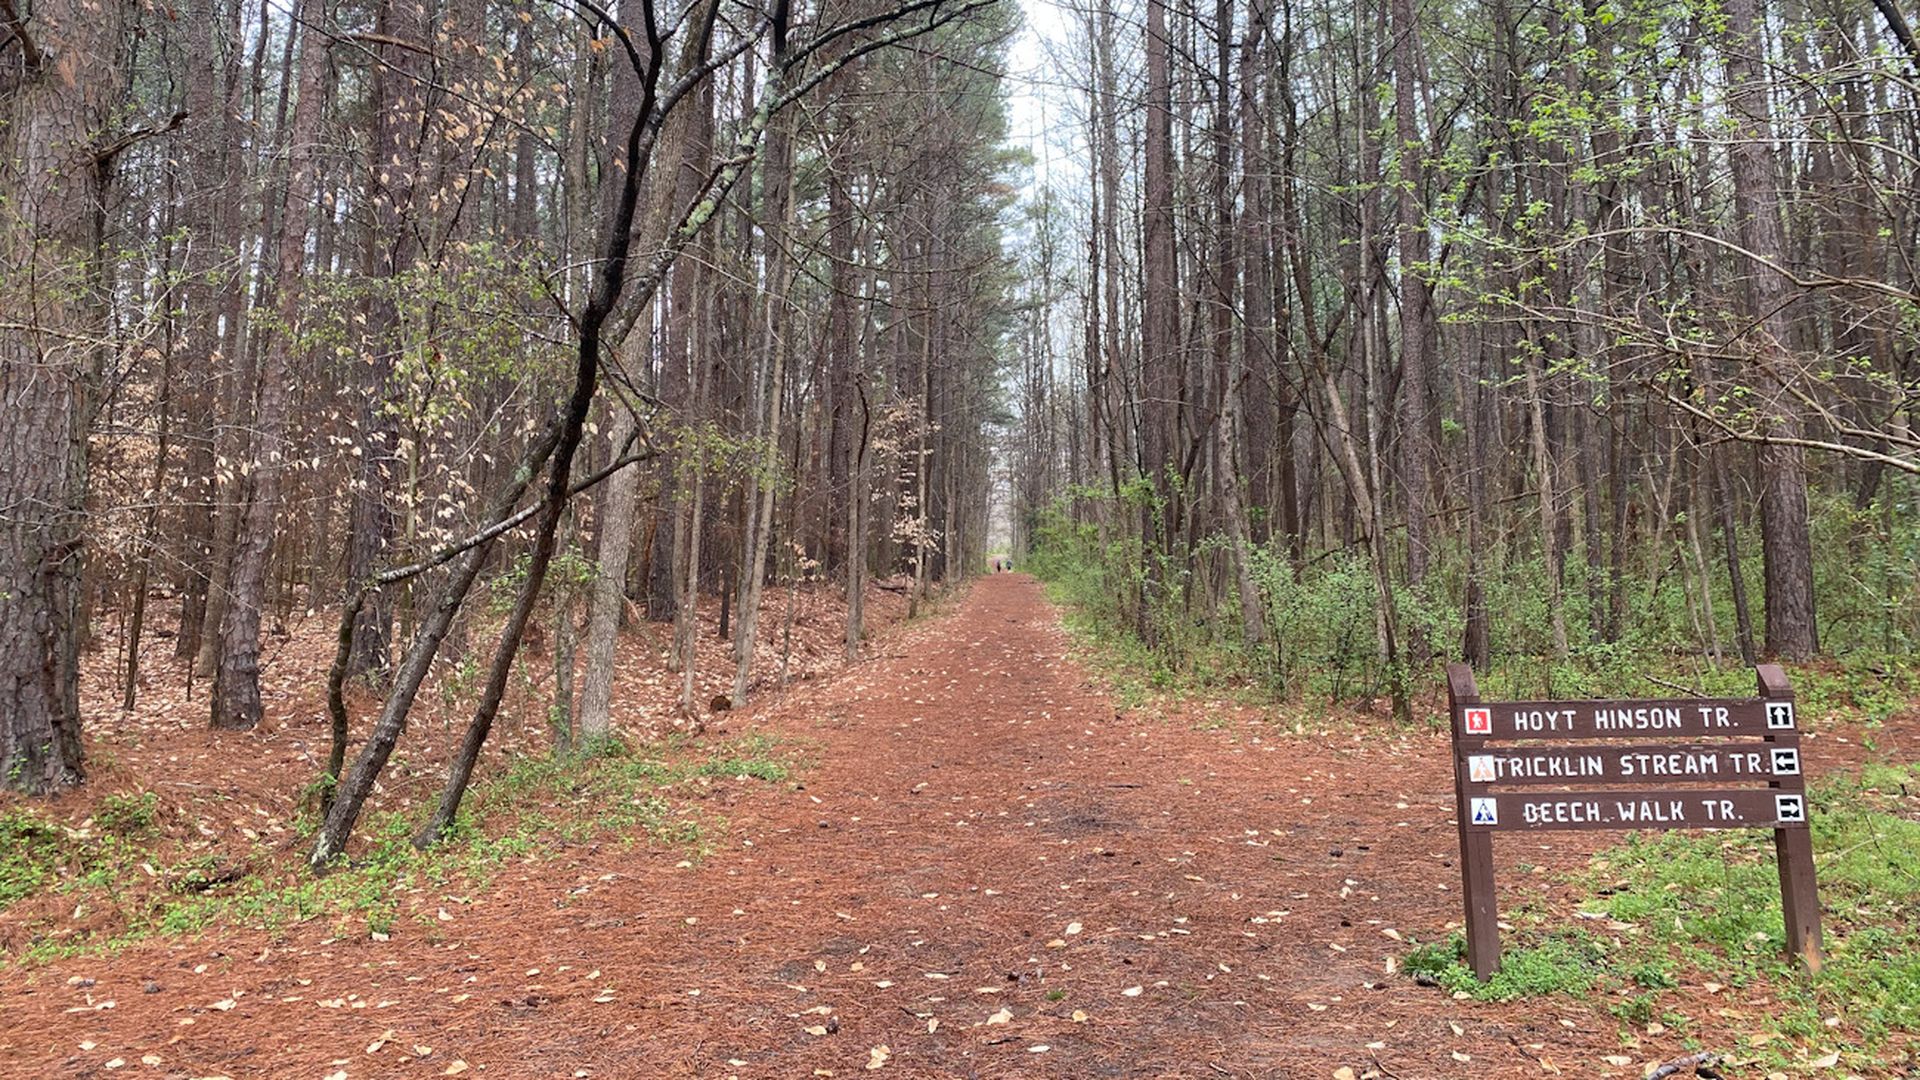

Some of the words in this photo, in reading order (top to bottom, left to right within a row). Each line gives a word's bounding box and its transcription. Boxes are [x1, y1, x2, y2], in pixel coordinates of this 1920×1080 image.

[1514, 710, 1577, 731] HOYT
[1595, 708, 1683, 731] HINSON
[1698, 707, 1740, 728] TR.
[1494, 754, 1604, 778] TRICKLIN
[1620, 753, 1718, 776] STREAM
[1729, 753, 1771, 774] TR.
[1523, 801, 1600, 824] BEECH
[1617, 801, 1685, 822] WALK
[1702, 800, 1744, 821] TR.
